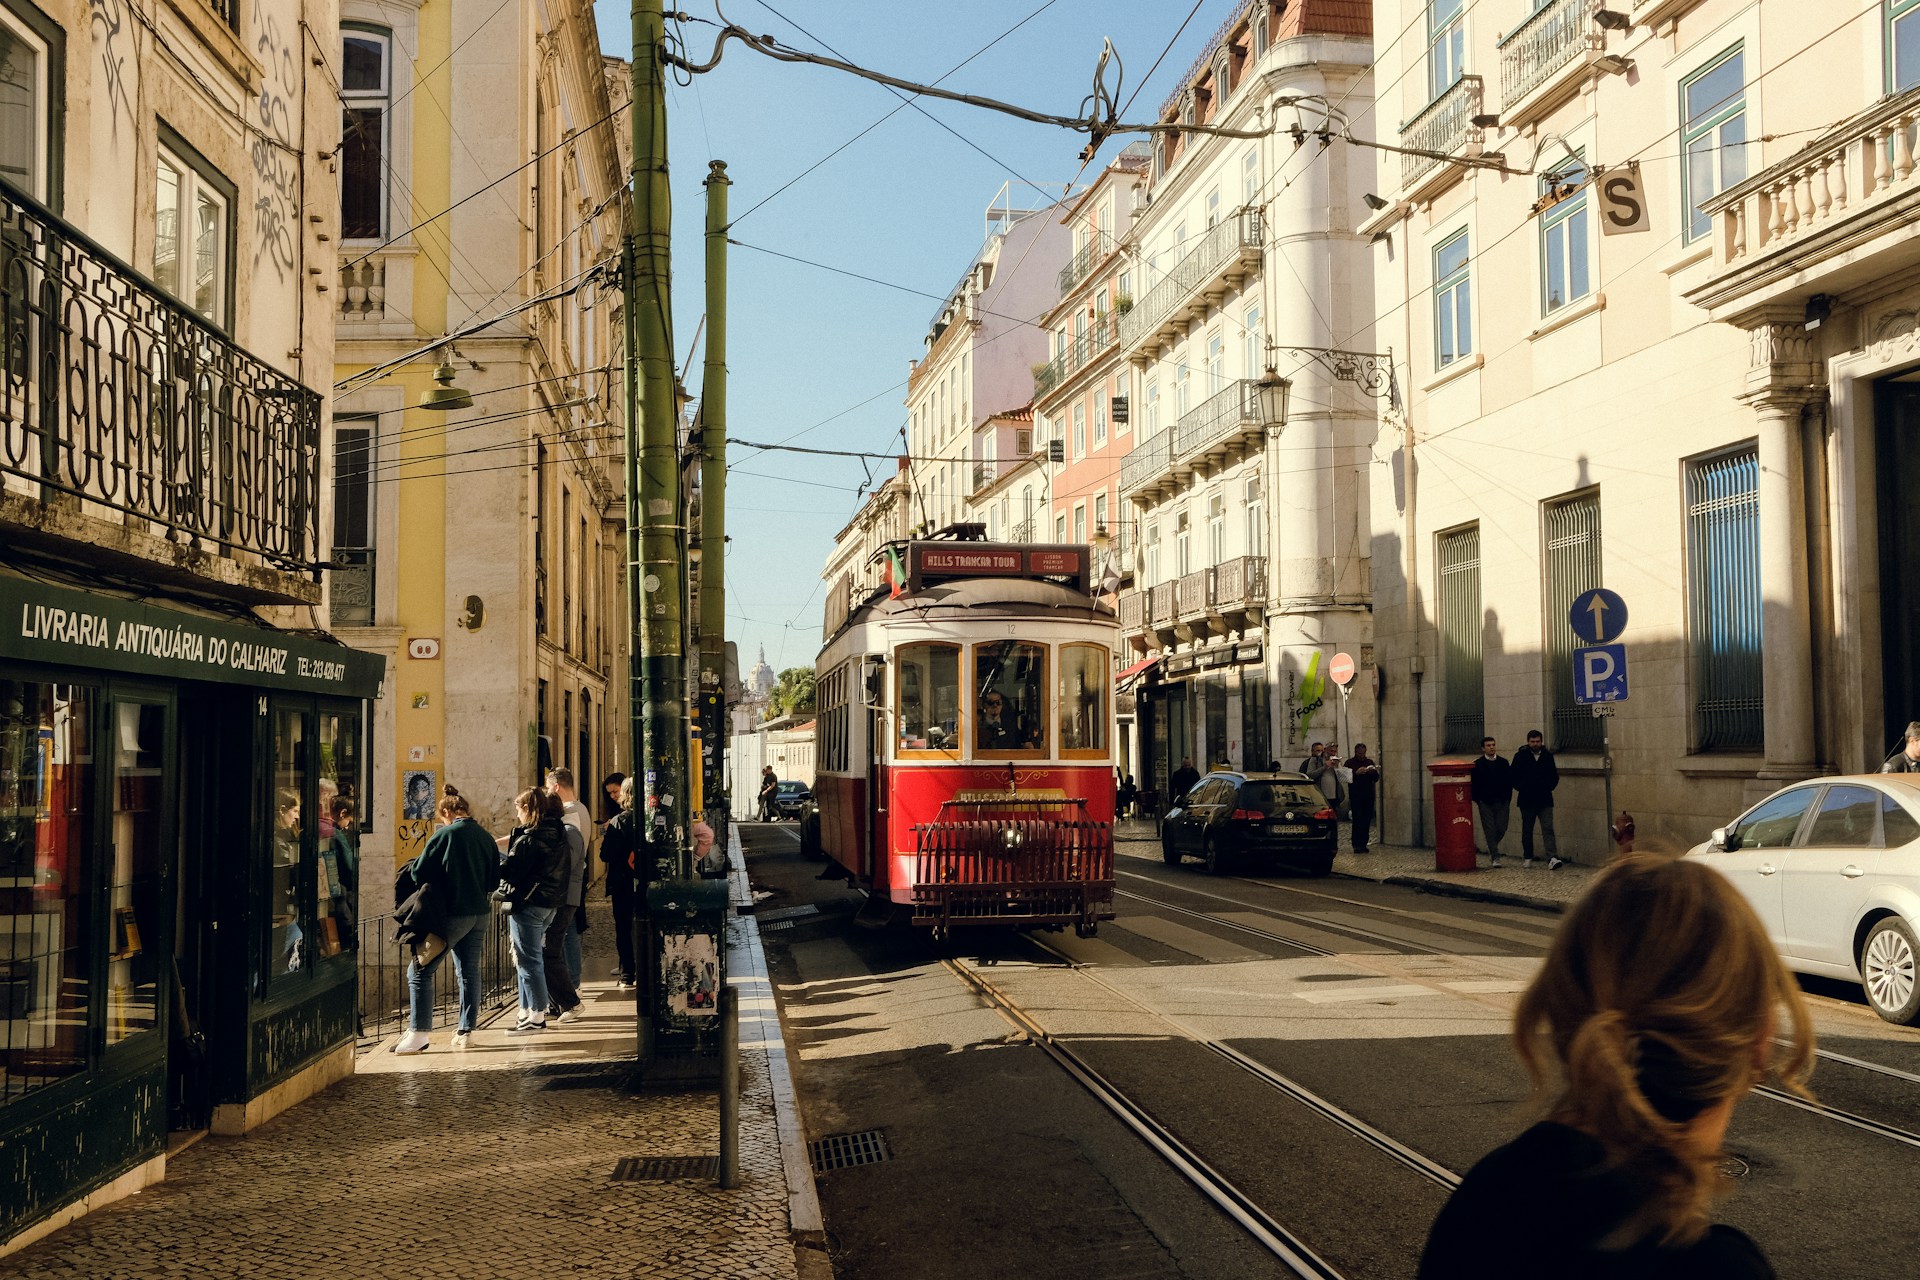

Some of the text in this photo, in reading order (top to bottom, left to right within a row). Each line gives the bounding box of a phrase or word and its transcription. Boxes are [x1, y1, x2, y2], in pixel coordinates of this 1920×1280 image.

[1604, 177, 1641, 227] S
[927, 555, 953, 567] HILLS
[993, 556, 1015, 568] TOUR
[22, 603, 287, 675] LIVRARIA ANTIQUÁRIA DO CALHARIZ
[1007, 624, 1016, 635] 12
[297, 656, 312, 677] TEL:
[312, 659, 324, 678] 213
[334, 663, 346, 682] 477
[1583, 651, 1615, 699] P
[257, 696, 268, 716] 14
[1296, 697, 1324, 719] Food
